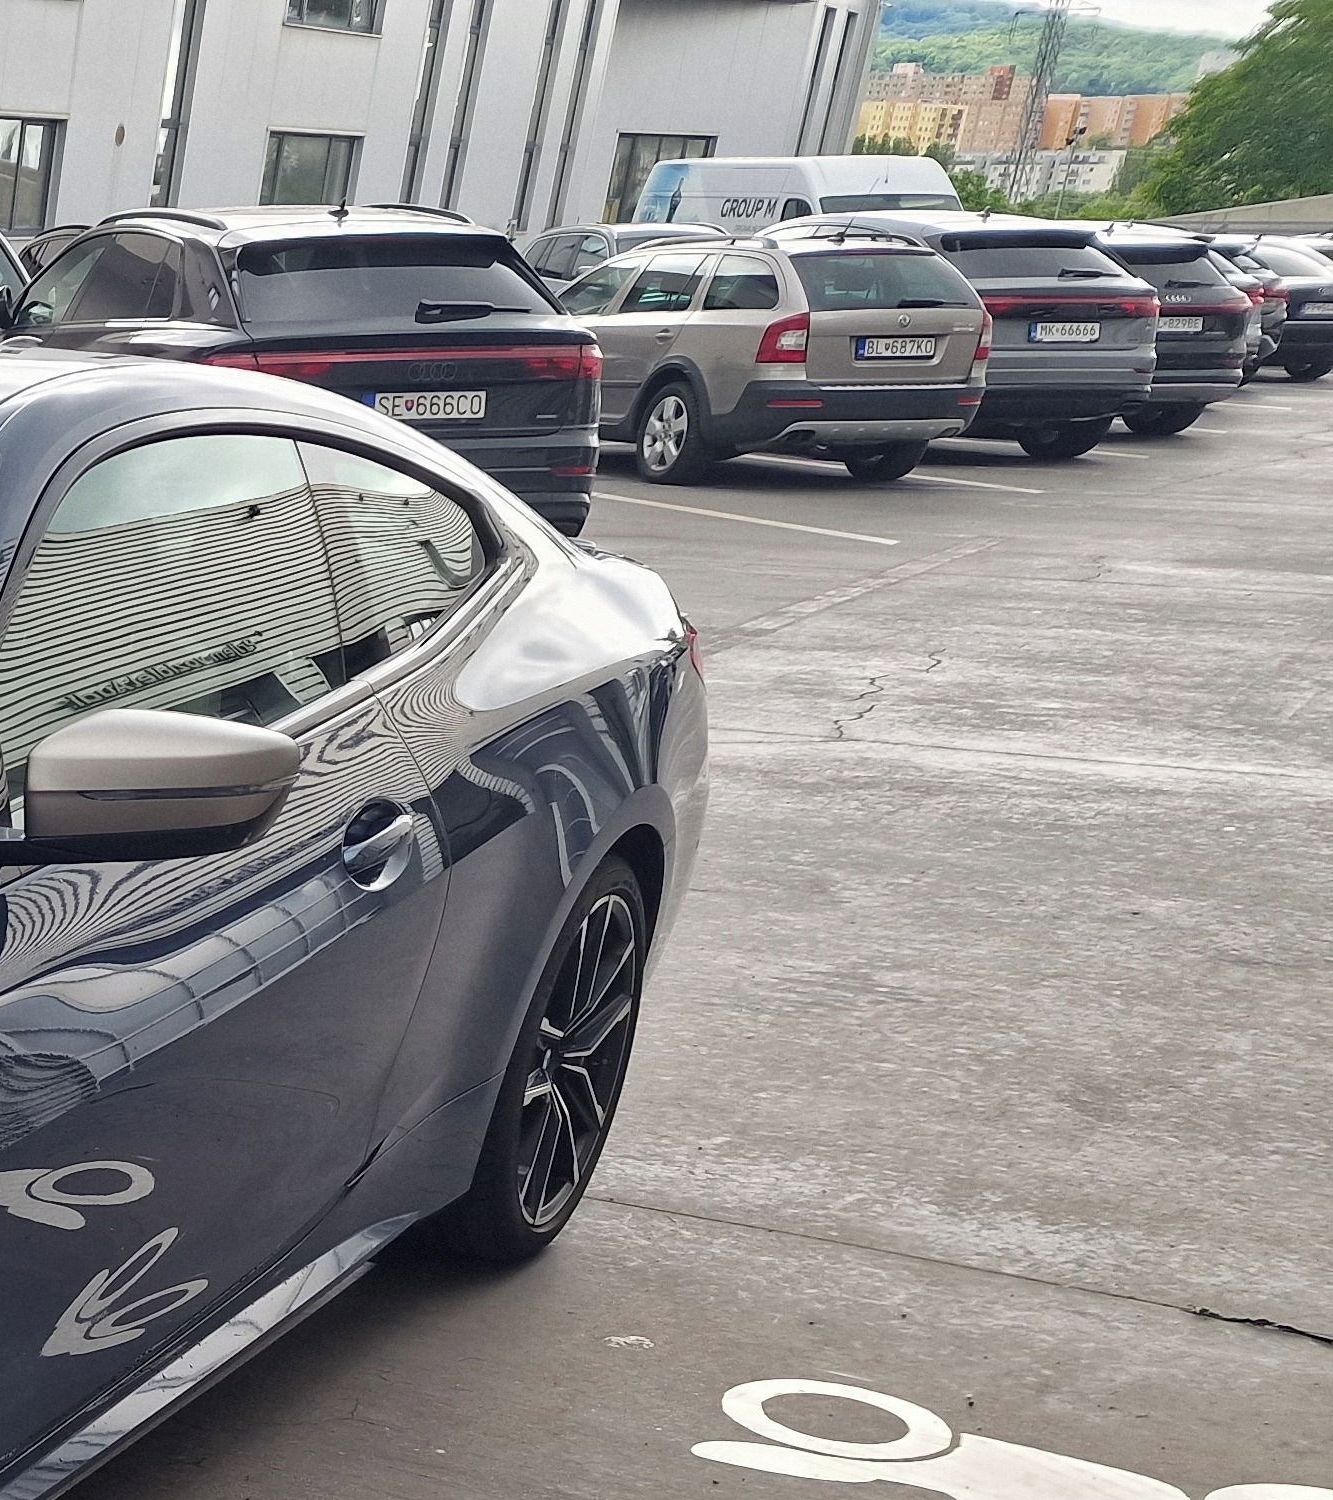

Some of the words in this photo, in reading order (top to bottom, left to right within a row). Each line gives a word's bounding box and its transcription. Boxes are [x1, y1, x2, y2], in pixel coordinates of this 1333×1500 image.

[720, 198, 764, 218] GROUP
[763, 199, 778, 218] M
[1040, 324, 1055, 337] MK
[1061, 324, 1096, 337] 66666
[866, 340, 883, 355] BL
[890, 339, 934, 355] 687KO
[378, 396, 403, 417] SE
